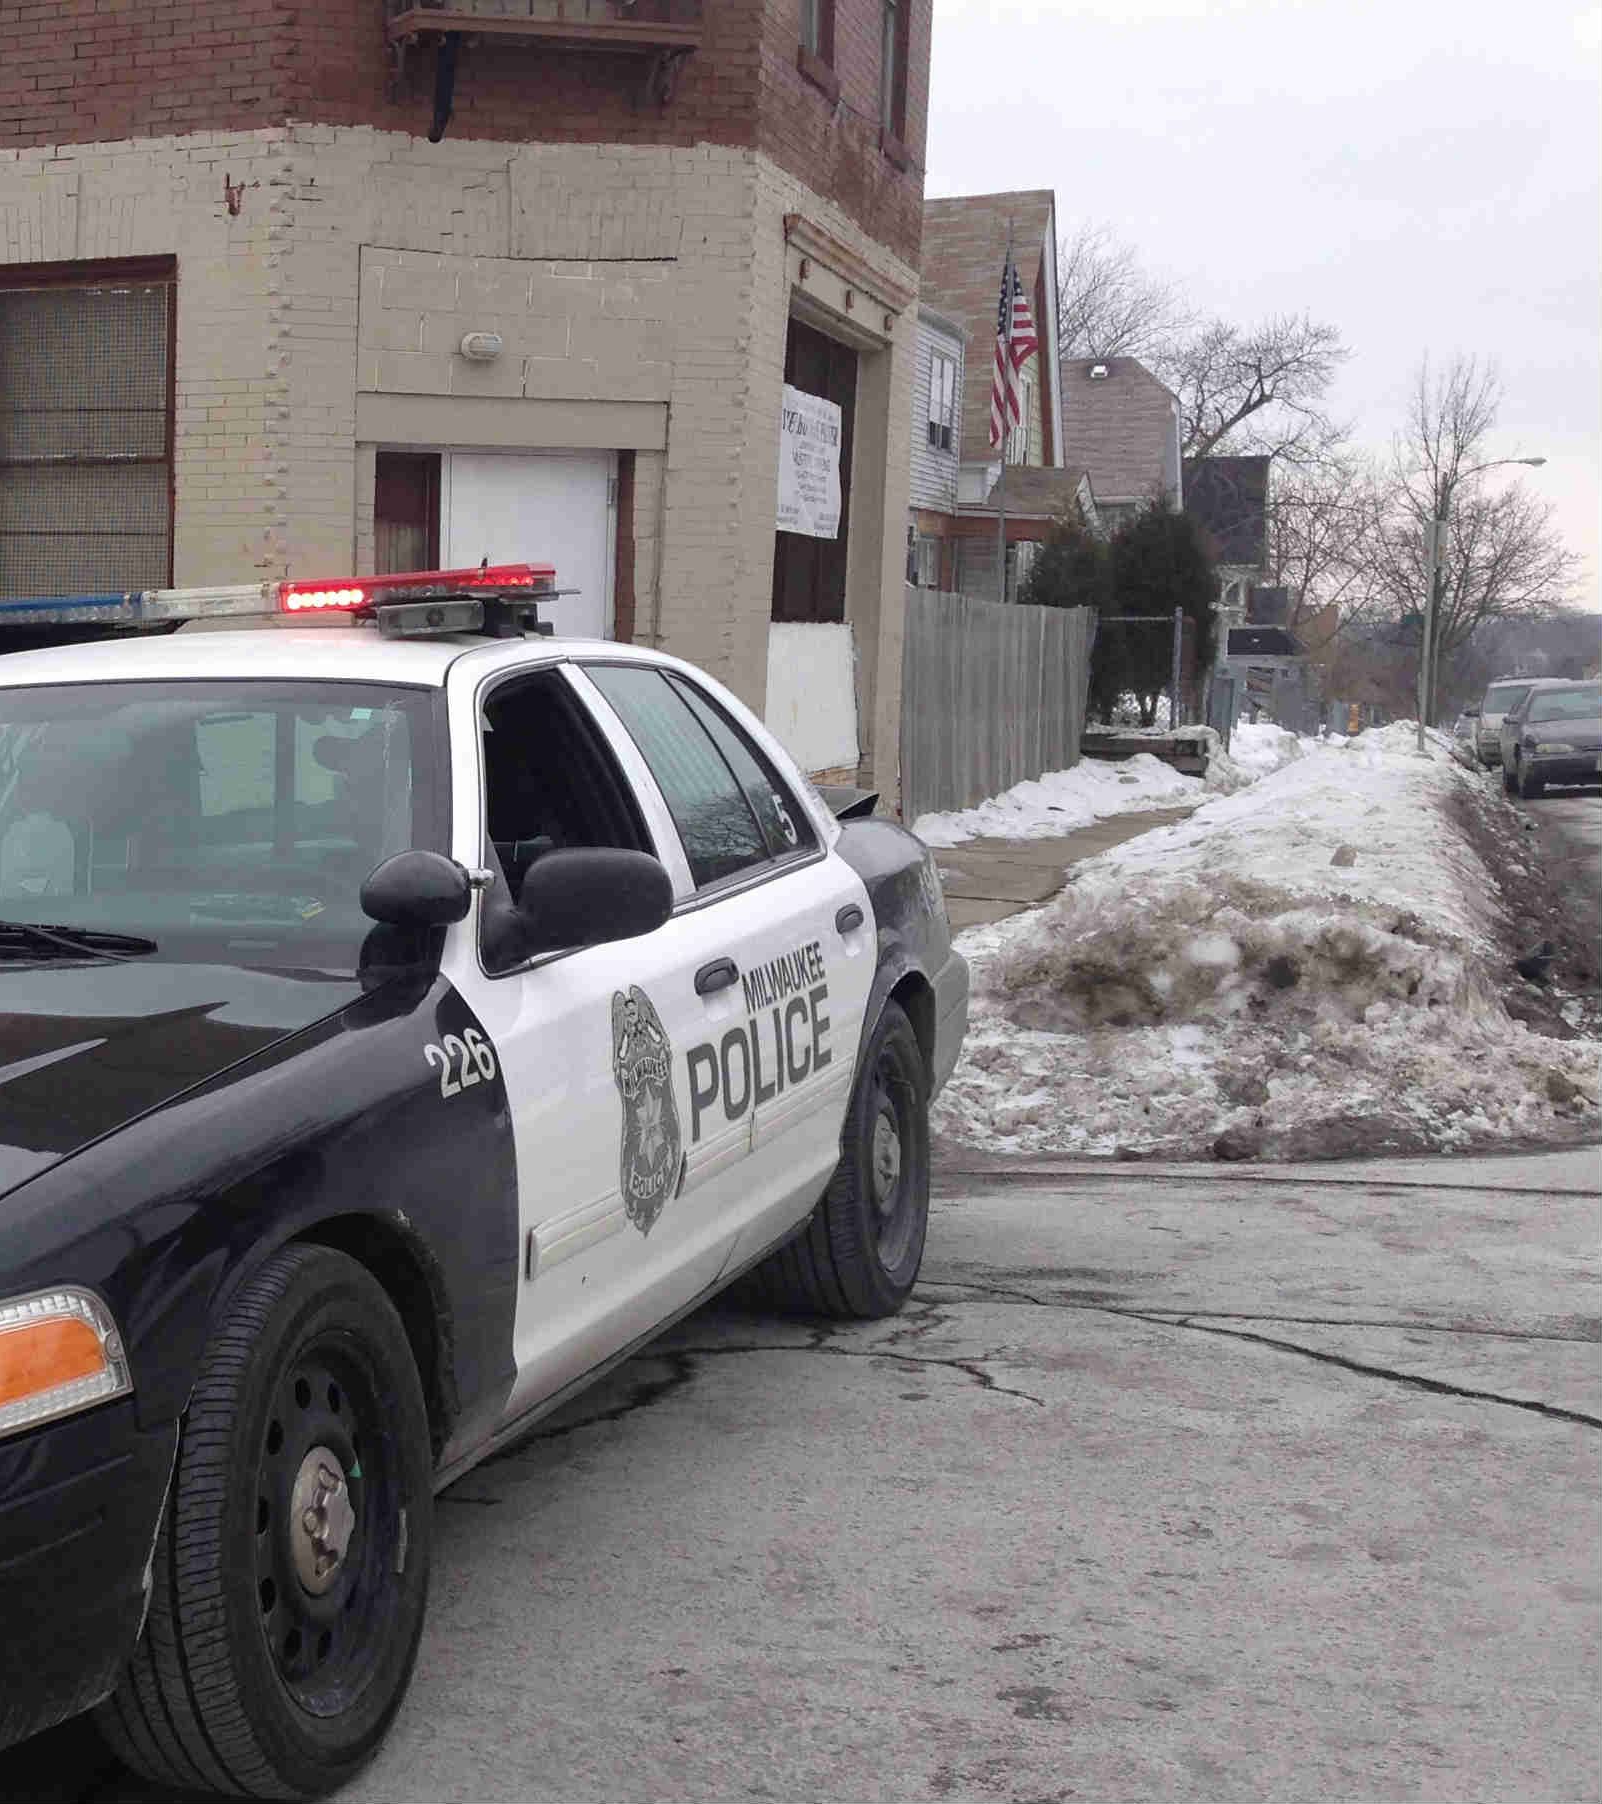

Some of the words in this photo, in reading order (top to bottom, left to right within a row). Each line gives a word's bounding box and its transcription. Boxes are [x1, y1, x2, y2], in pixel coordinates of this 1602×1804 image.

[741, 940, 826, 1015] MILWAUKEE
[423, 1027, 496, 1099] 226
[686, 983, 833, 1143] POLICE
